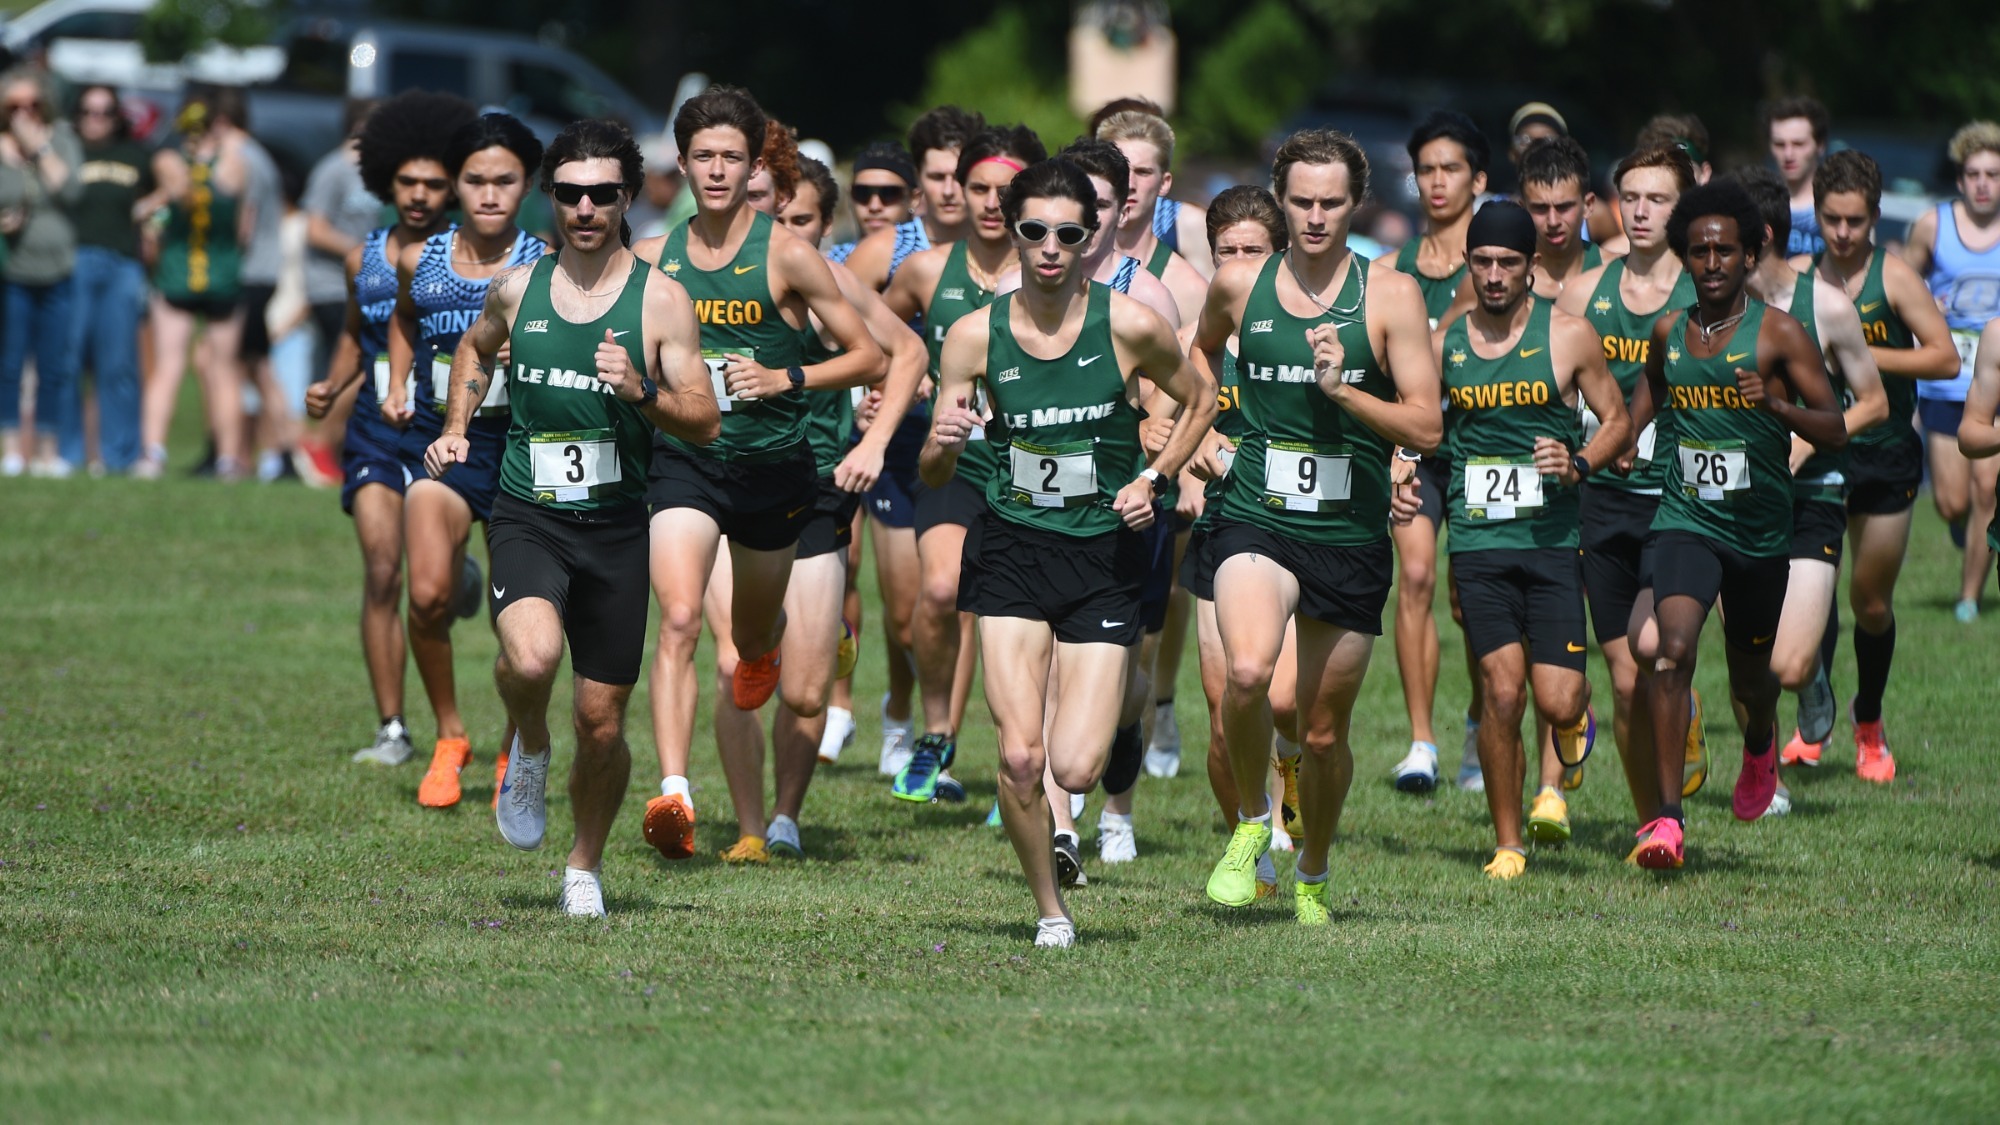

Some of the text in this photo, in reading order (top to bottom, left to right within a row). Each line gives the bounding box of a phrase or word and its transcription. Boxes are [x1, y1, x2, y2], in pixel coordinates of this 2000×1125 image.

[524, 320, 549, 331] NEC
[691, 300, 763, 325] WEGO
[1250, 320, 1273, 331] NEC
[1603, 335, 1650, 364] SWE
[518, 363, 545, 384] LE
[999, 367, 1020, 382] NEC
[1248, 362, 1366, 383] LE MONE
[1450, 380, 1549, 411] OSWEGO
[1003, 401, 1116, 429] LE MOYNE
[563, 445, 584, 483] 3
[1040, 458, 1061, 492] 2
[1298, 456, 1317, 494] 9
[1694, 453, 1728, 486] 26
[1486, 467, 1521, 502] 24
